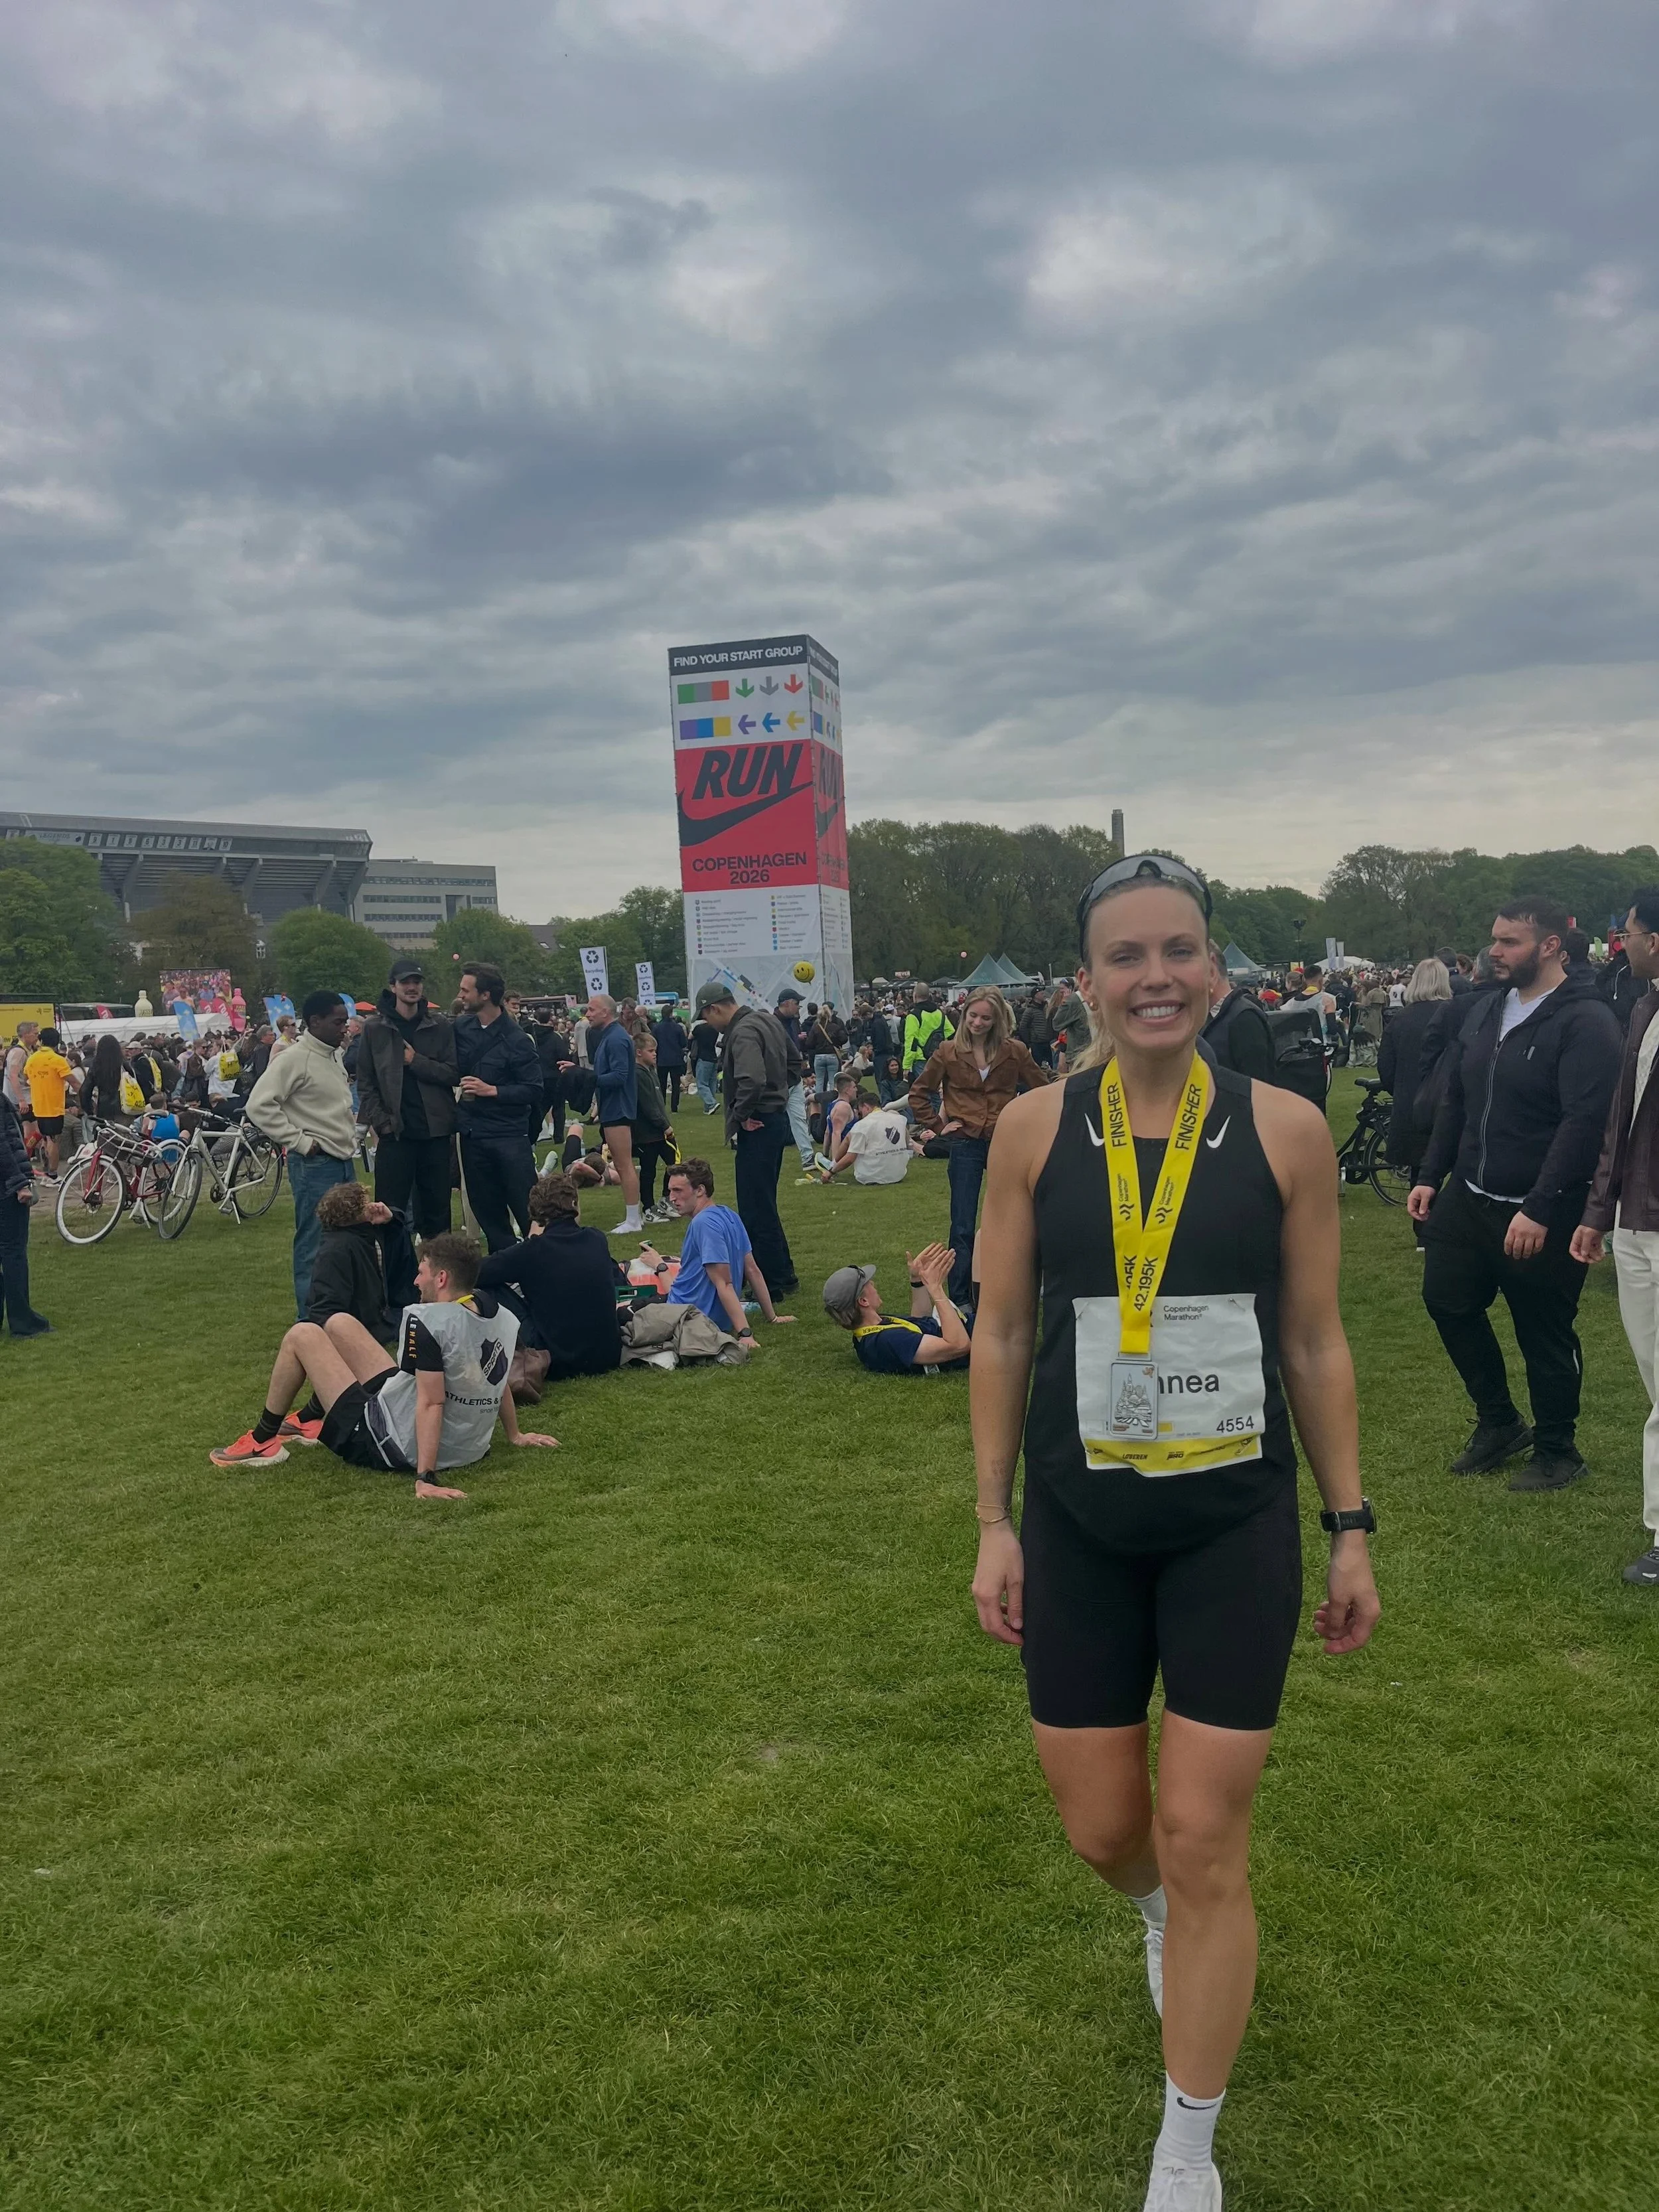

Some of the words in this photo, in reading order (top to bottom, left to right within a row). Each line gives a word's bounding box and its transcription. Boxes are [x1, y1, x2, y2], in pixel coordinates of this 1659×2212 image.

[674, 656, 697, 667] FIND
[699, 652, 729, 664] YOUR
[731, 649, 763, 662] START
[765, 646, 803, 658] GROUP
[691, 743, 804, 800] RUN
[692, 852, 807, 872] COPENHAGEN
[730, 869, 770, 884] 2026
[1108, 1082, 1127, 1147] FINISHER
[1175, 1084, 1201, 1149] FINISHER
[1134, 1257, 1158, 1311] 42.195K
[1163, 1305, 1208, 1313] Copenhagen
[484, 1341, 502, 1376] SPARTA
[445, 1391, 492, 1406] ATHLETICS
[1216, 1416, 1254, 1433] 4554
